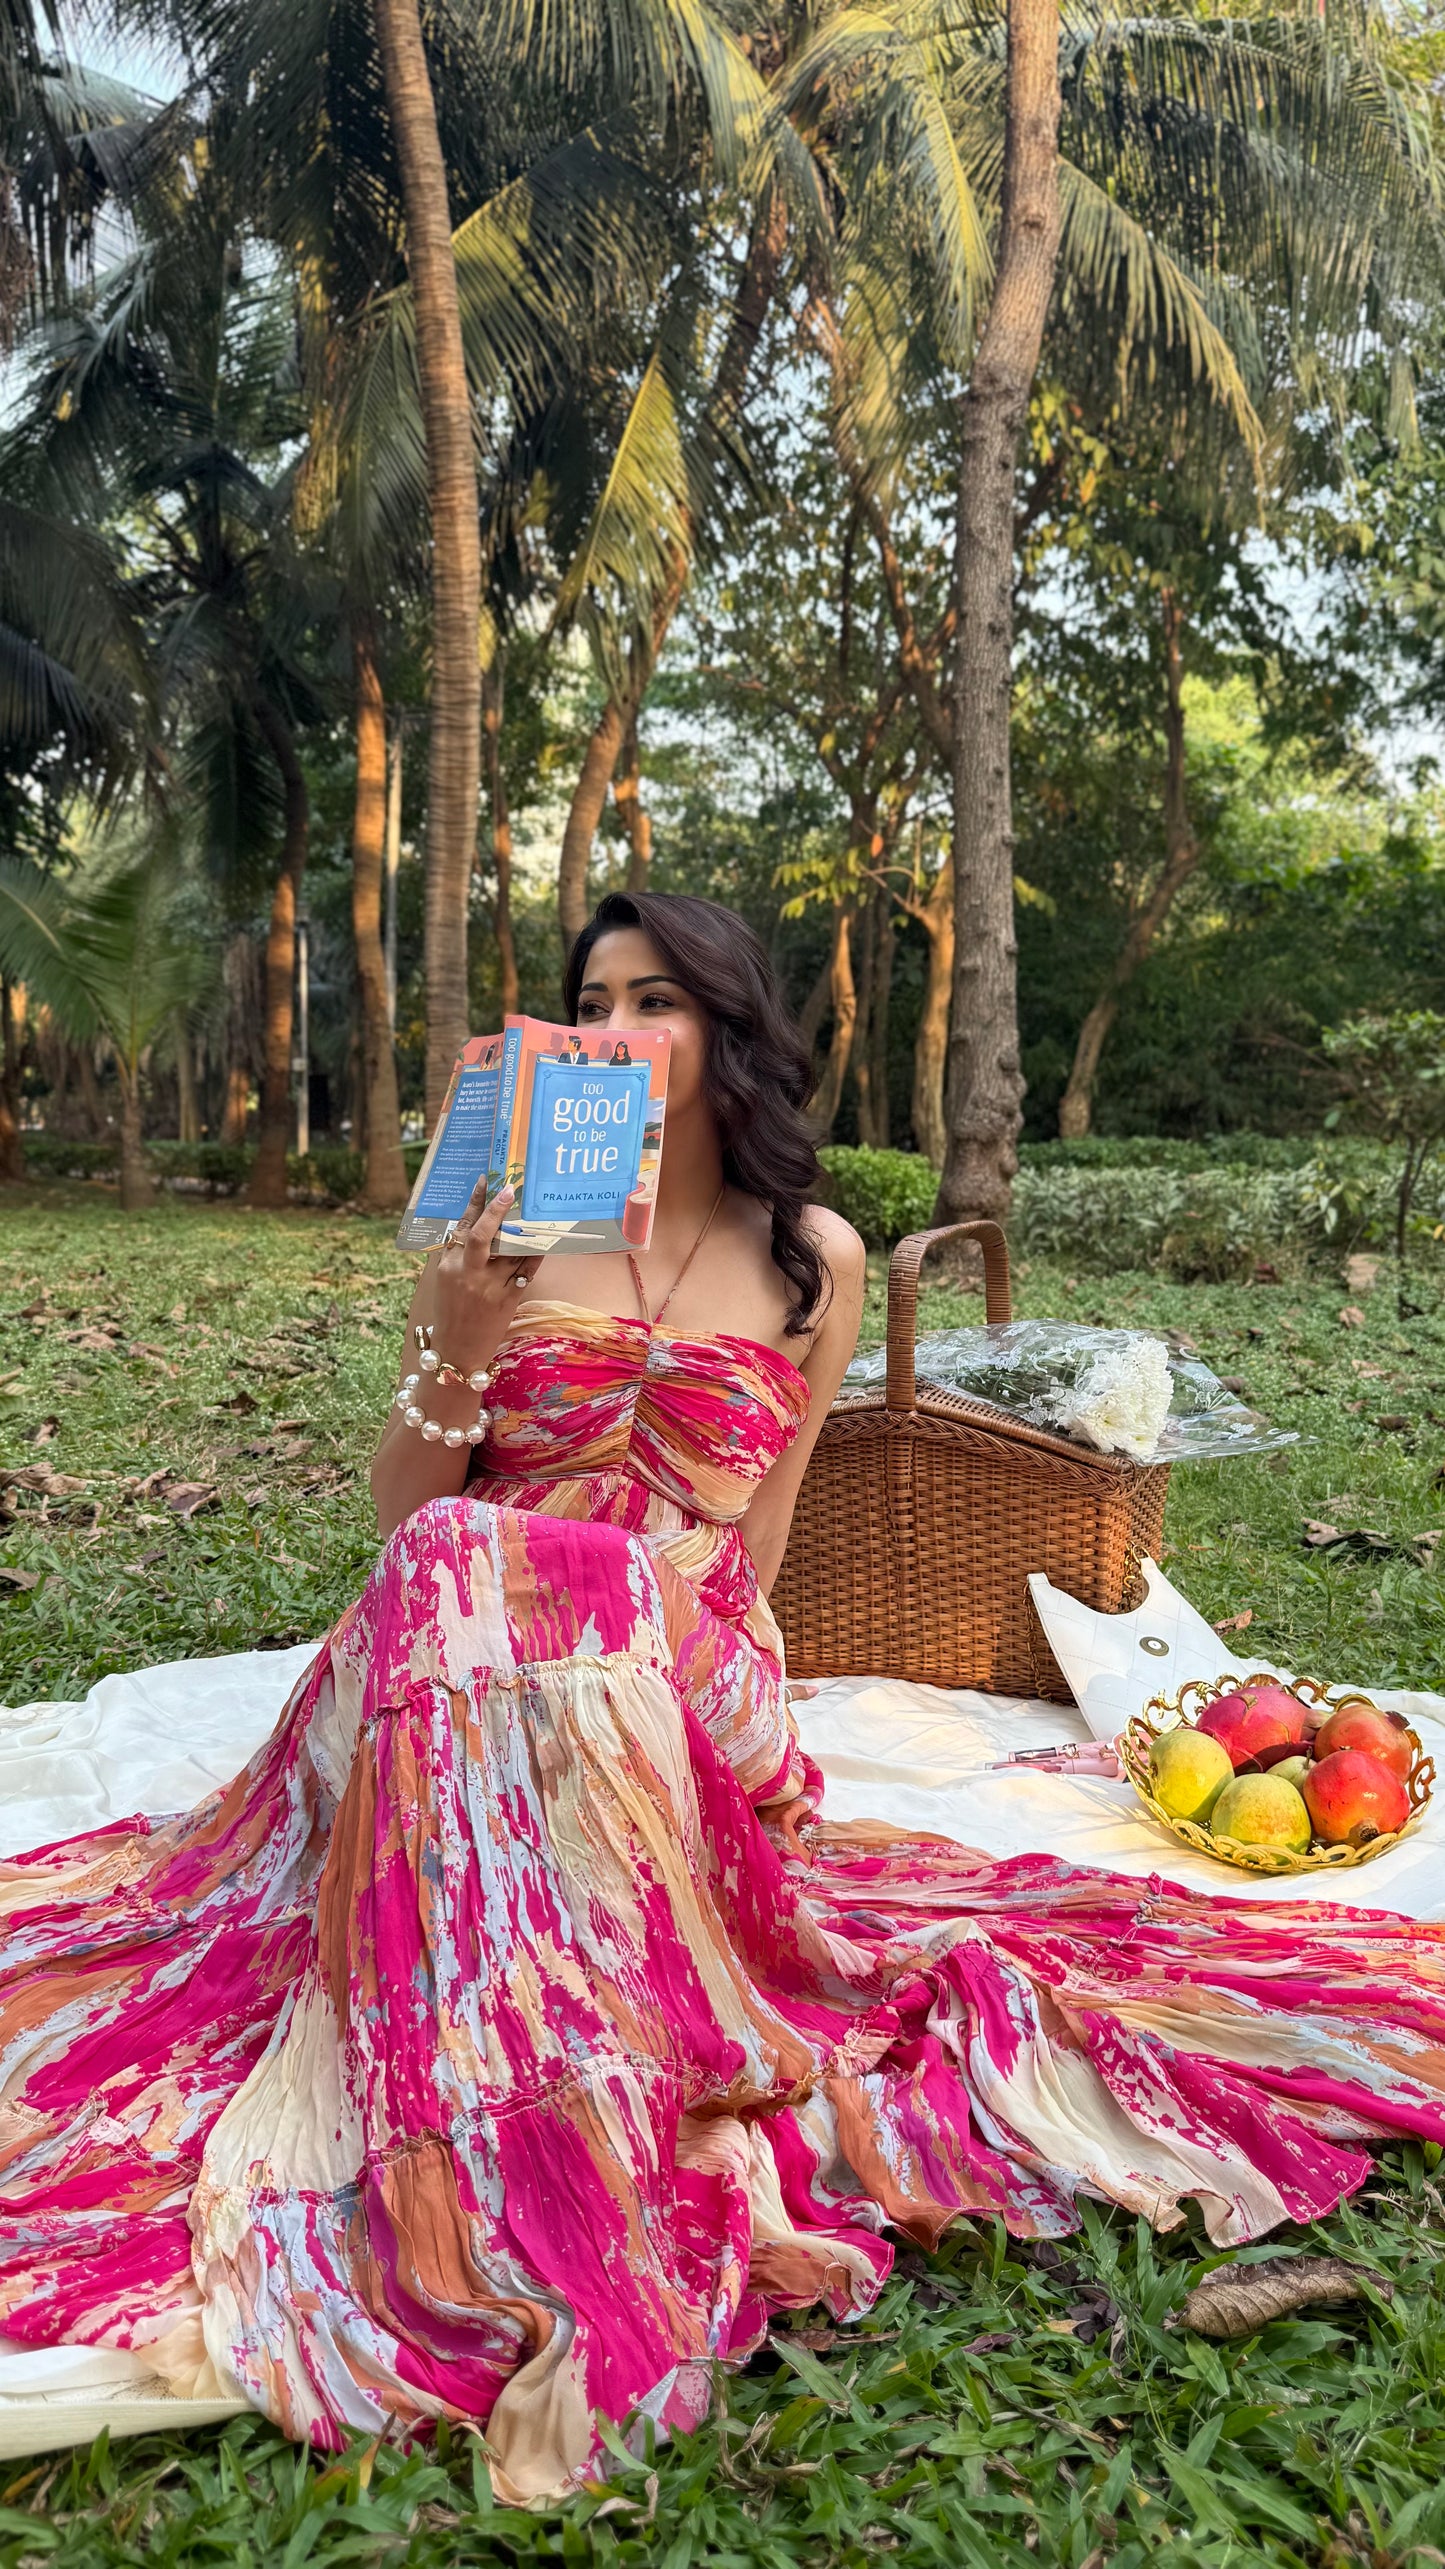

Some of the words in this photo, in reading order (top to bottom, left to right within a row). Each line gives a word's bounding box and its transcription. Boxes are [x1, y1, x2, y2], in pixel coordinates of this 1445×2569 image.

[508, 1037, 518, 1052] too
[505, 1053, 515, 1076] good
[504, 1076, 513, 1086] to
[582, 1082, 604, 1095] too
[503, 1086, 514, 1098] be
[500, 1100, 511, 1120] true
[553, 1089, 631, 1132] good
[574, 1130, 587, 1143] to
[590, 1128, 607, 1142] be
[499, 1129, 508, 1165] PRAJAKTA
[555, 1143, 619, 1175] true
[543, 1192, 594, 1201] PRAJAKTA
[597, 1191, 620, 1200] KOLI
